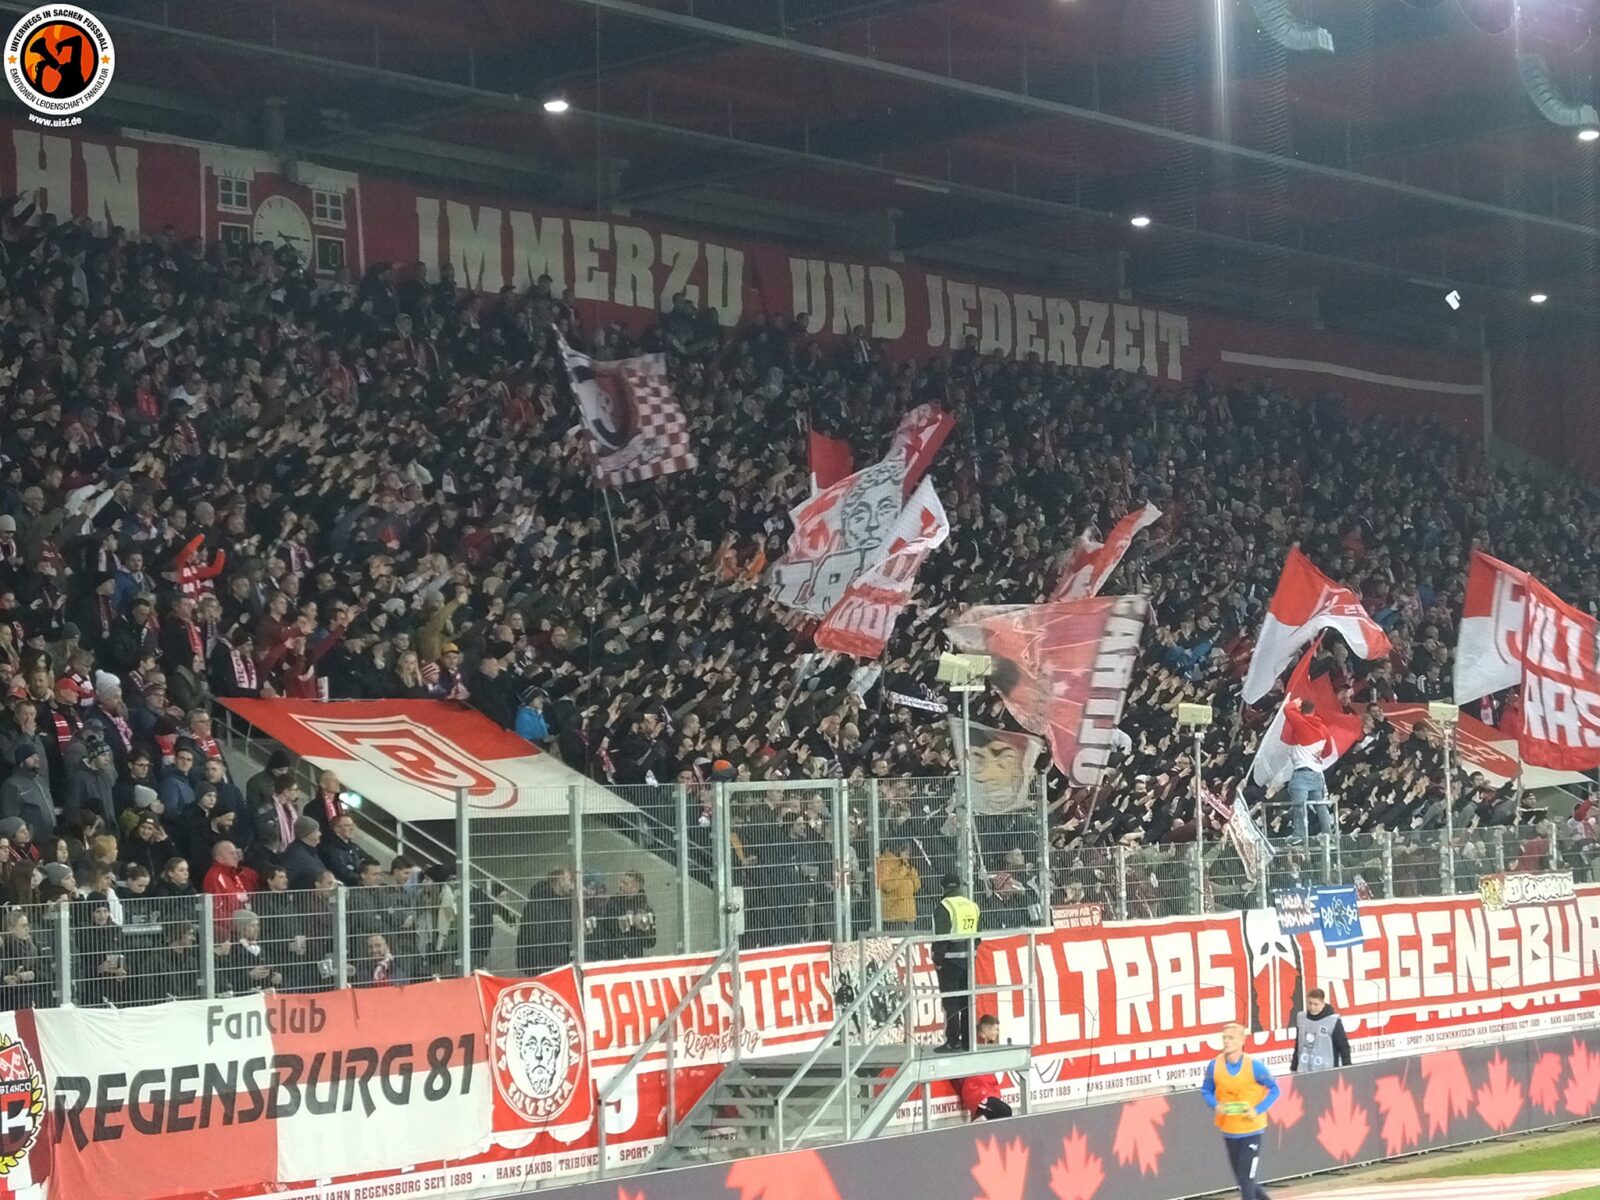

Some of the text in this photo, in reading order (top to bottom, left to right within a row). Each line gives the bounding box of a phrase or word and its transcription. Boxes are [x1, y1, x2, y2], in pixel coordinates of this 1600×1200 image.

[415, 196, 1189, 382] IMMERZU UND JEDERZEIT
[206, 1001, 326, 1046] Fanclub
[590, 960, 835, 1050] JAHNGSTERS
[991, 928, 1237, 1049] ULTRAS
[53, 1032, 476, 1152] REGENSBURG 81
[1040, 1088, 1054, 1100] SEIT
[1056, 1086, 1071, 1096] 1889
[354, 1180, 420, 1200] REGENSBURG
[424, 1176, 446, 1190] SEIT
[450, 1172, 473, 1187] 1889
[496, 1164, 522, 1180] HANS
[525, 1160, 553, 1176] JAKOB
[620, 1146, 652, 1162] SPORT-
